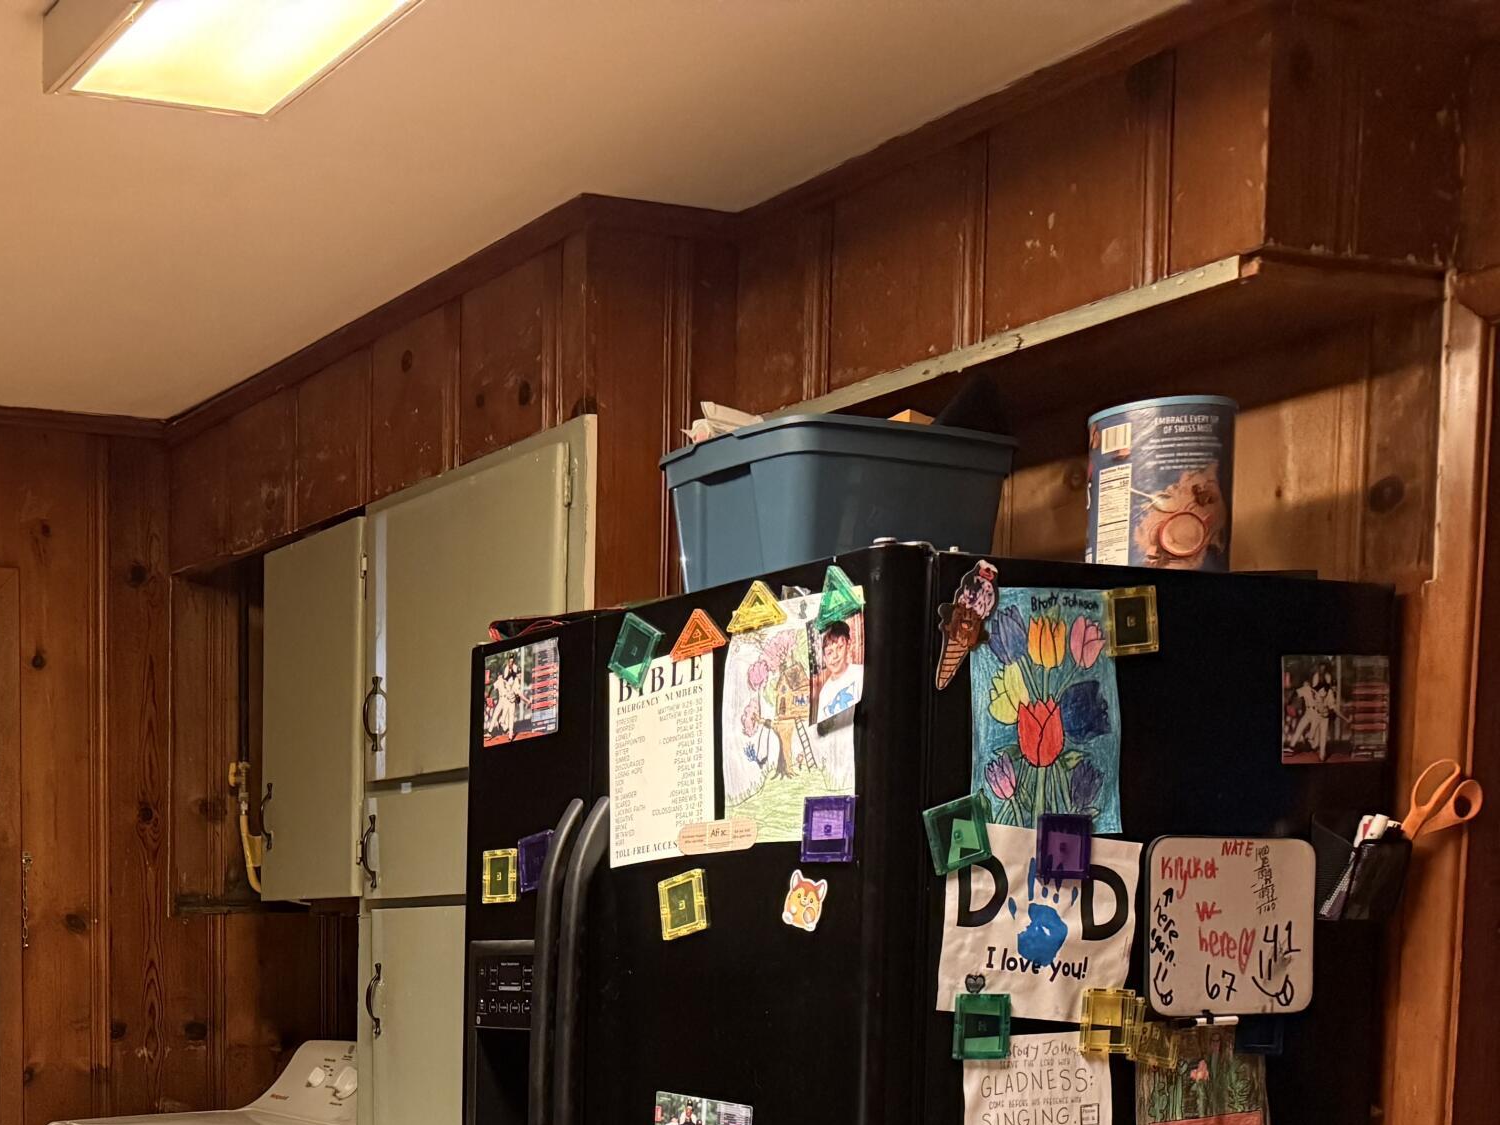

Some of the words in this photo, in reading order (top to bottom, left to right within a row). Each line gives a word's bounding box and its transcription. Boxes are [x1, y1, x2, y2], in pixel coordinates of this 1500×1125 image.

[1189, 414, 1209, 424] EVERY
[1163, 425, 1172, 434] OF
[1174, 424, 1196, 434] SWISS
[616, 695, 659, 715] EMERGENCY
[665, 684, 702, 701] NUMBERS
[659, 711, 681, 721] MATTHEW
[676, 716, 693, 725] PSALM
[676, 723, 693, 733] PSALM
[677, 739, 694, 748] PSALM
[676, 747, 693, 756] PSALM
[674, 755, 690, 765] PSALM
[677, 762, 694, 772] PSALM
[652, 804, 682, 816] COLOSSIANS
[675, 811, 692, 819] PSALM
[652, 841, 678, 851] ACCES
[1221, 840, 1254, 856] NATE
[1263, 920, 1301, 962] 41
[986, 946, 996, 969] I
[1001, 947, 1041, 975] love
[1049, 956, 1088, 982] you!
[1206, 964, 1237, 1002] 67
[981, 1068, 1093, 1098] GLADNESS:
